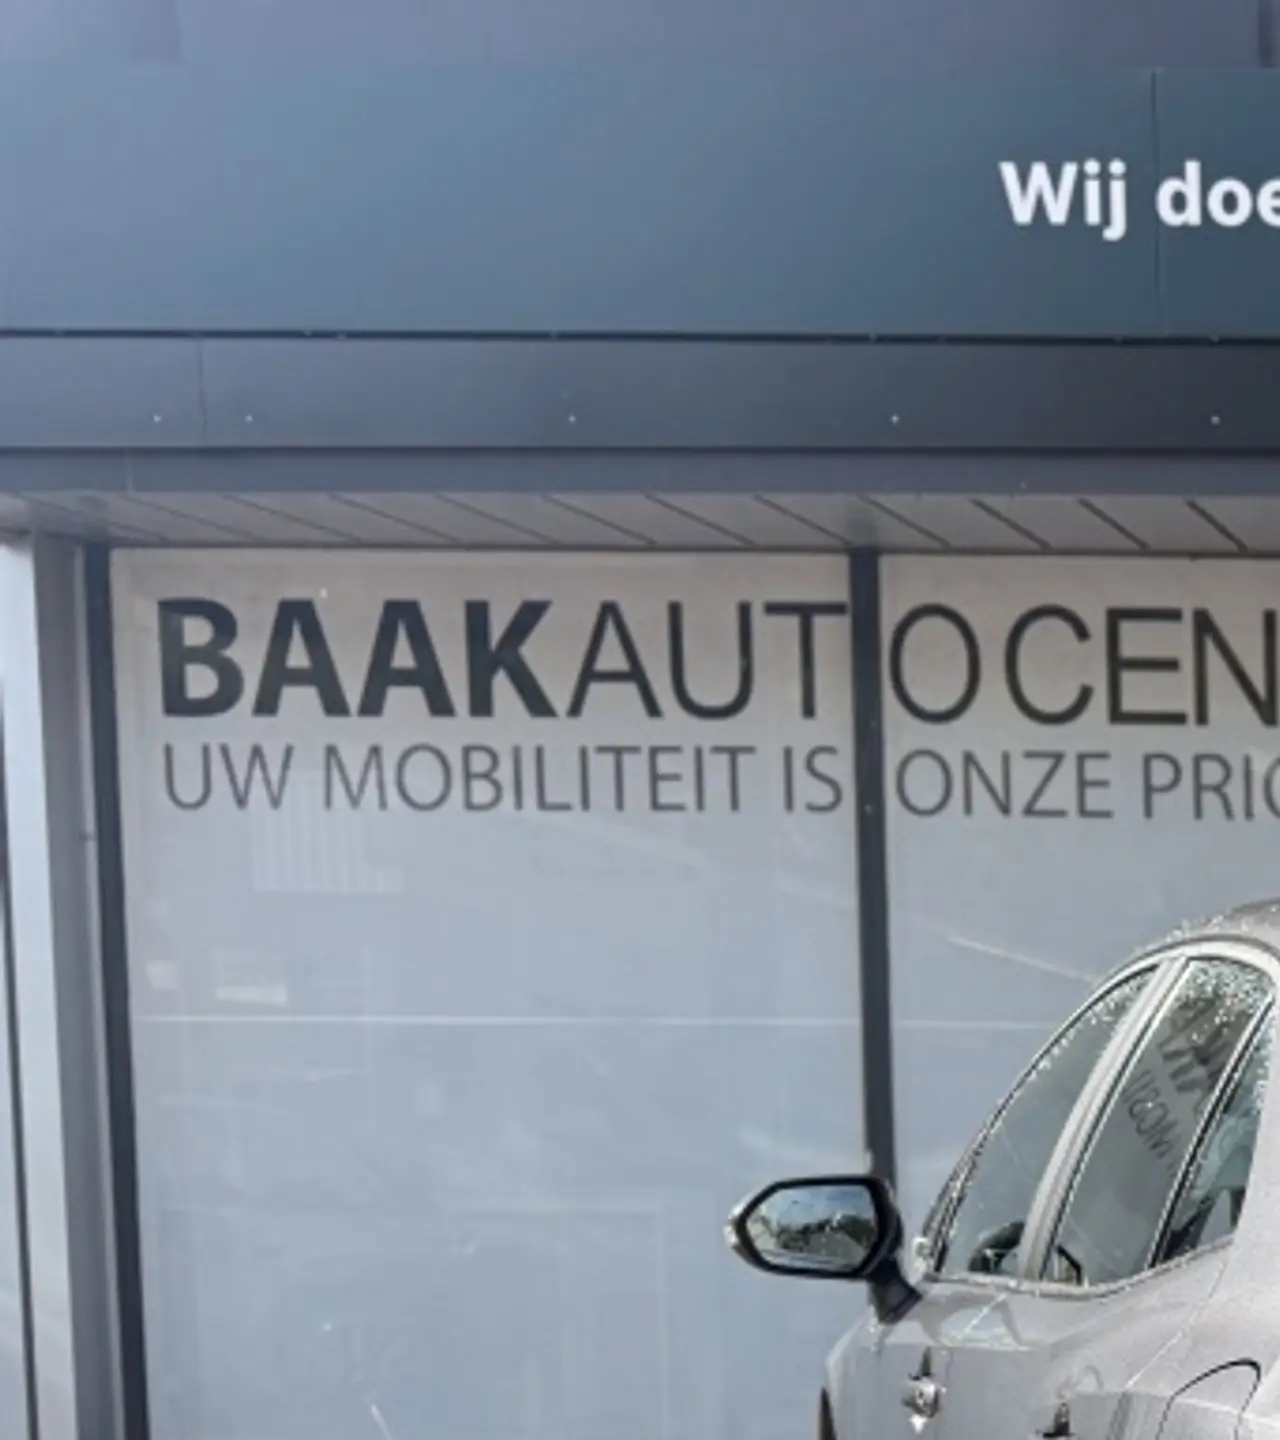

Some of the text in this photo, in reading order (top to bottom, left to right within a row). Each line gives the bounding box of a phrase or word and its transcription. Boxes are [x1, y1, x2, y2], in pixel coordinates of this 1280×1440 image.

[998, 157, 1127, 242] Wij
[163, 743, 293, 811] UW
[323, 744, 756, 812] MOBILITEIT
[783, 744, 843, 813] IS
[895, 748, 1113, 819] ONZE
